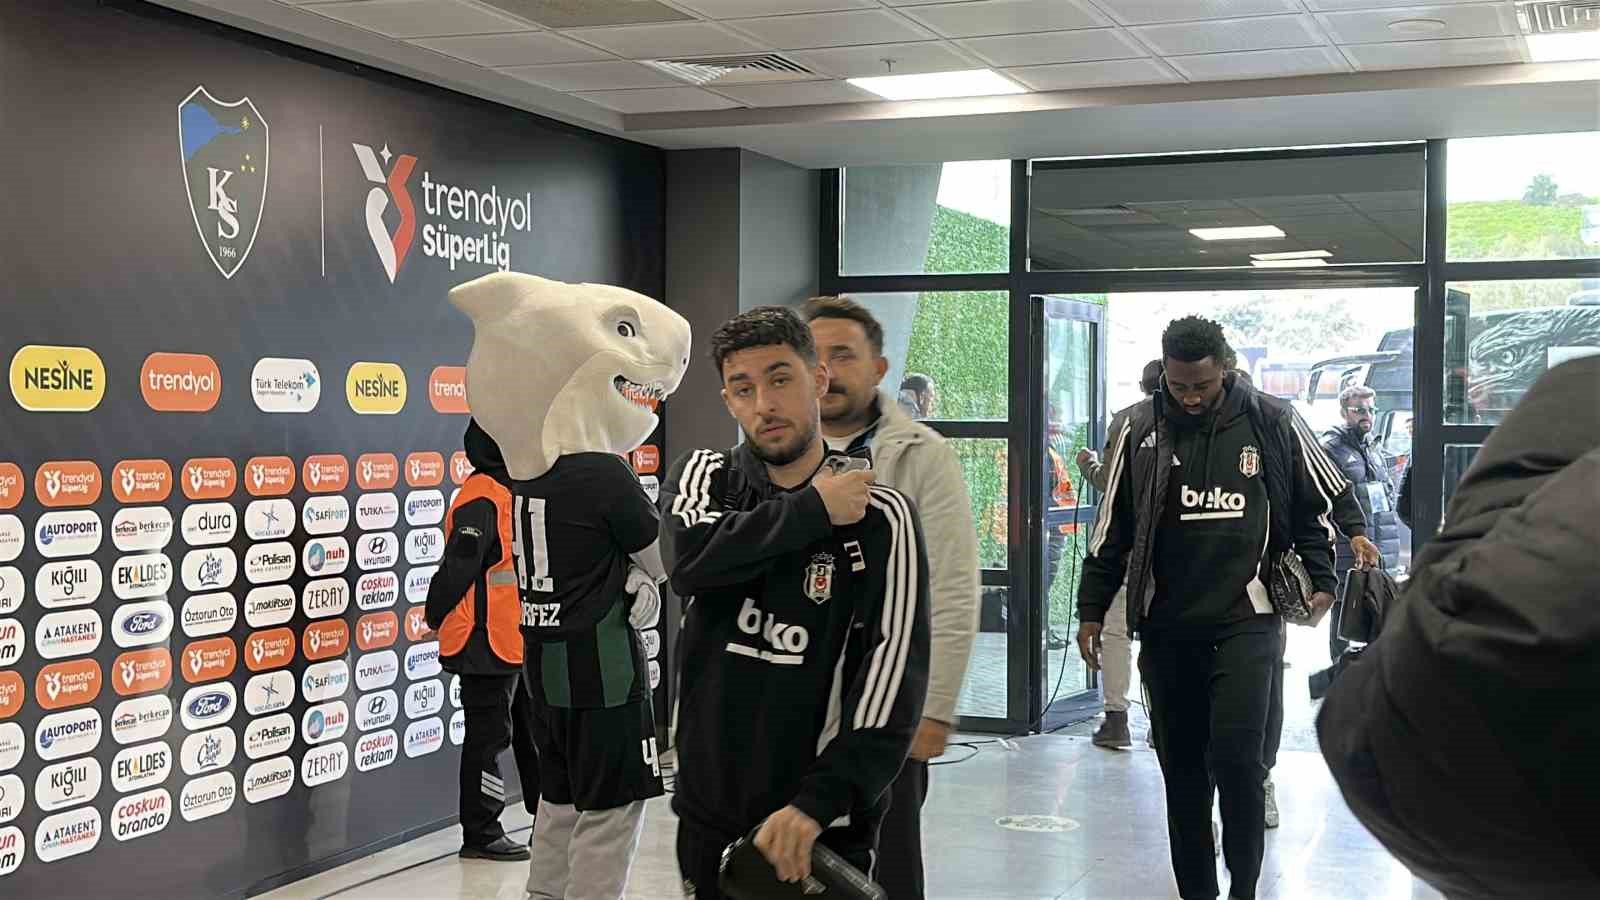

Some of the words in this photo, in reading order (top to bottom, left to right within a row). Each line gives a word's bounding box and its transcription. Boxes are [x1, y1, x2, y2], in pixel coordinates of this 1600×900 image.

[421, 171, 532, 236] trendyol
[218, 246, 237, 258] 1966
[422, 224, 511, 272] SüperLig
[148, 369, 214, 396] trendyol
[273, 378, 304, 390] Telekom
[62, 472, 95, 486] trendyol
[136, 471, 166, 482] trendyol
[412, 498, 442, 511] AUTOPORT
[1180, 485, 1246, 511] beko
[47, 521, 98, 535] AUTOPORT
[198, 512, 231, 531] dura
[262, 554, 291, 566] Polisan
[326, 547, 345, 560] nuh
[364, 555, 392, 566] HYUNDAI
[361, 576, 394, 592] coşkun
[308, 586, 344, 610] ZERAY
[361, 590, 394, 606] reklam
[219, 606, 234, 618] Oto
[54, 621, 96, 638] ATAKENT
[130, 614, 157, 632] Ford
[62, 668, 95, 685] trendyol
[194, 696, 224, 716] Ford
[325, 711, 344, 727] nuh
[363, 713, 391, 728] HYUNDAI
[47, 718, 98, 738] AUTOPORT
[261, 725, 291, 741] Polisan
[117, 751, 166, 779] EKALDES
[307, 751, 344, 779] ZERAY
[360, 749, 393, 768] reklam
[218, 786, 233, 799] Oto
[118, 795, 165, 820] coşkun
[53, 819, 95, 841] ATAKENT
[118, 812, 165, 836] branda
